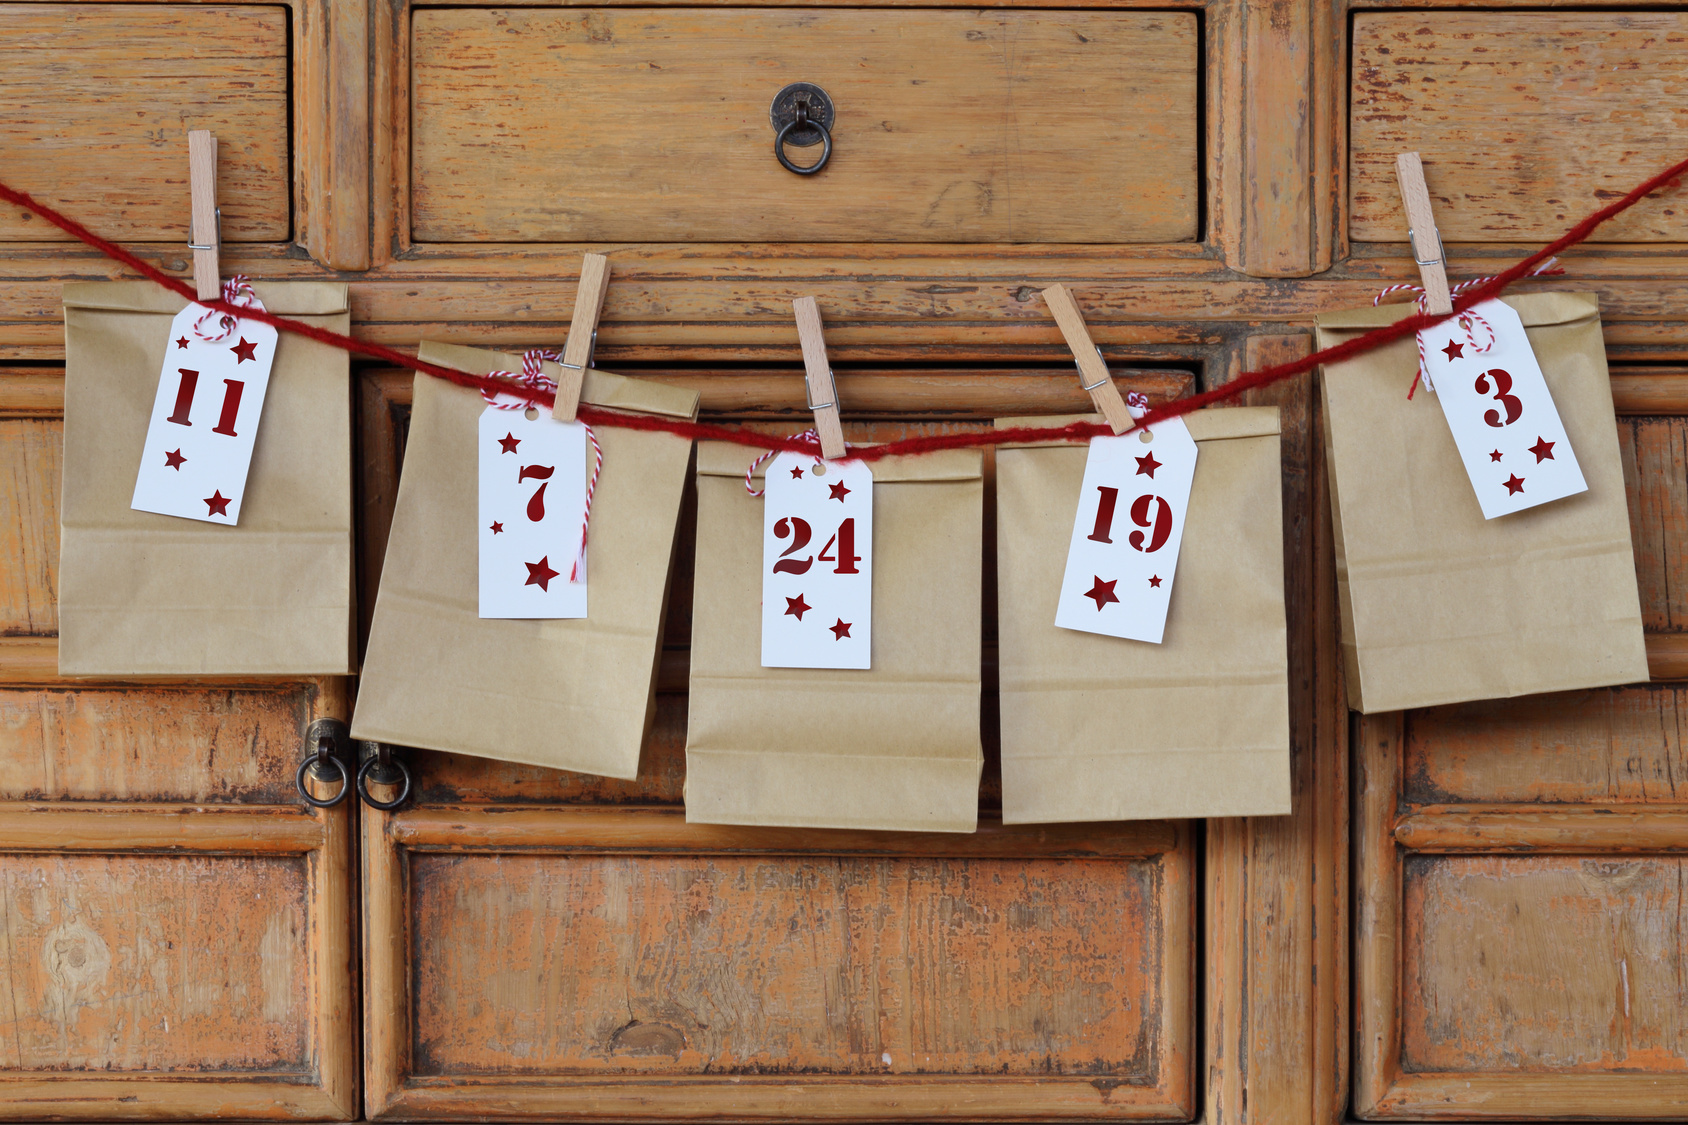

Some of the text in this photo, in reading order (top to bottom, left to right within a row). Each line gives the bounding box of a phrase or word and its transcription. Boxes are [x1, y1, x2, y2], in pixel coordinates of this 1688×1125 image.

[166, 368, 245, 437] 11
[1474, 368, 1523, 428] 3
[518, 464, 555, 522] 7
[1087, 485, 1173, 553] 19
[773, 516, 862, 575] 24
